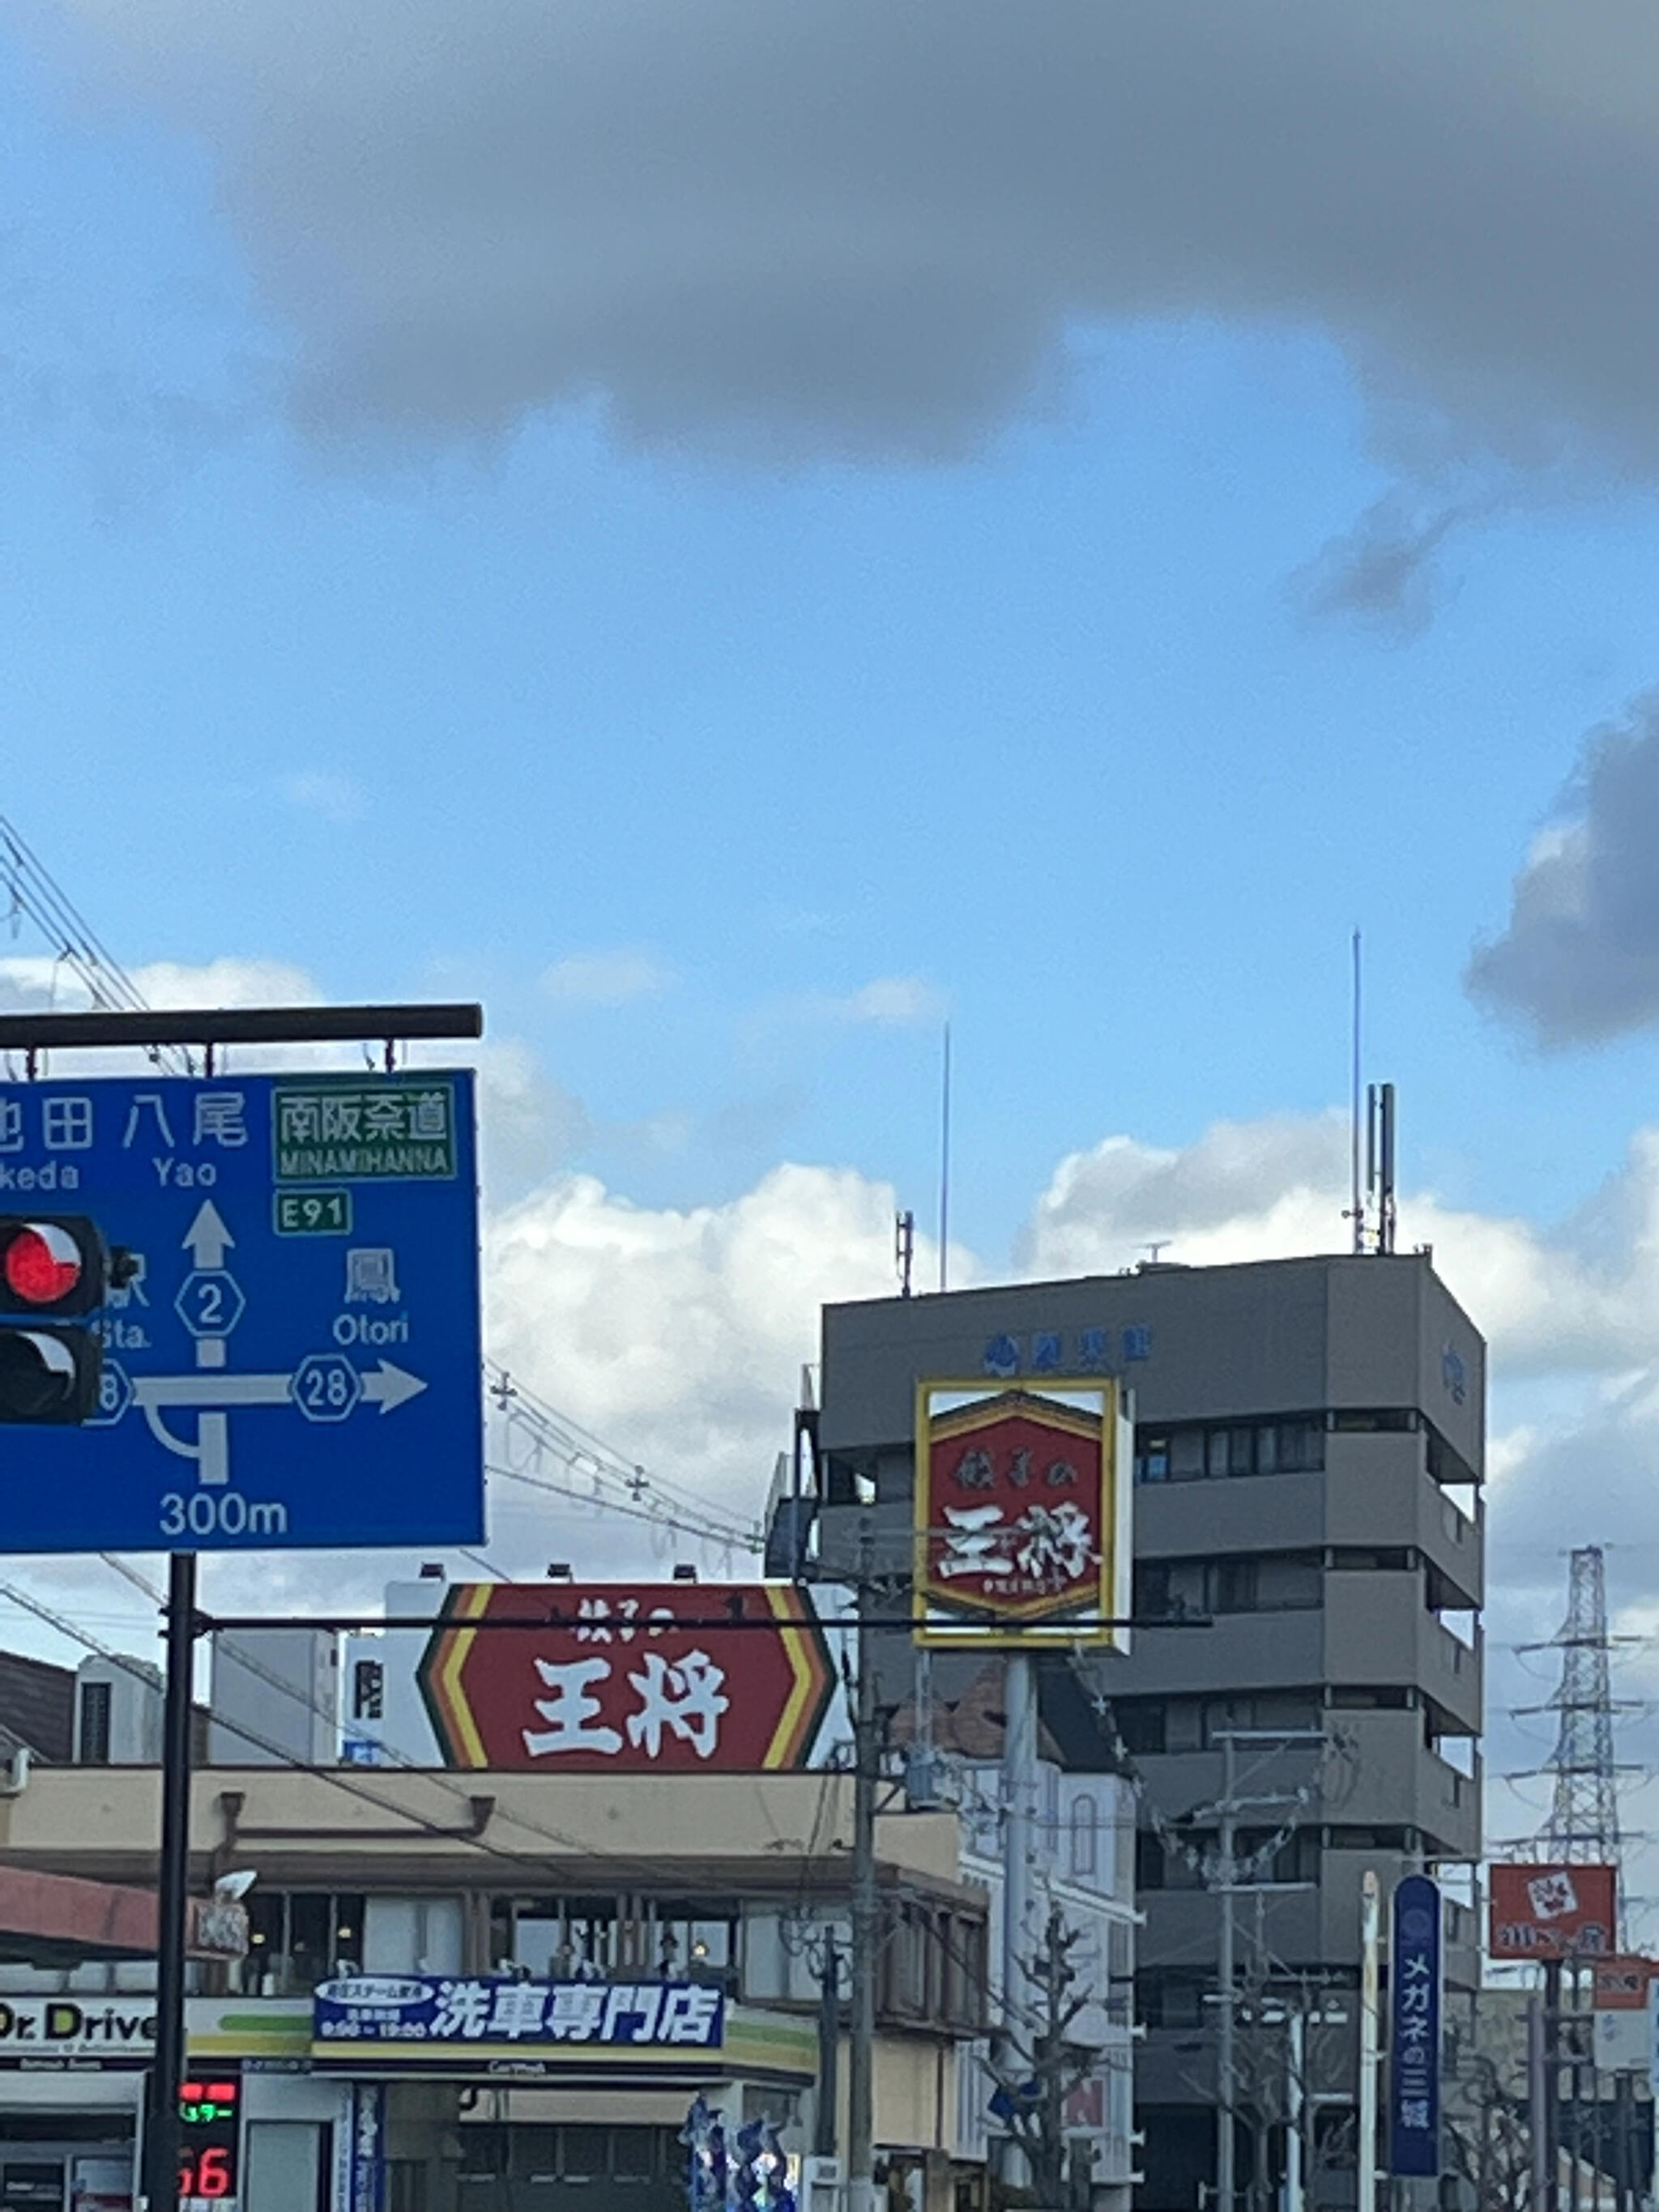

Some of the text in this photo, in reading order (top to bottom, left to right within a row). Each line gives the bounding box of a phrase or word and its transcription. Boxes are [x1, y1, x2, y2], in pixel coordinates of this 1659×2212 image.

[123, 1092, 248, 1149] 八尾
[280, 1092, 447, 1143] 南阪奈道
[151, 1157, 217, 1187] Yao
[280, 1148, 449, 1174] MINAMIHANNA
[284, 1196, 343, 1228] E91
[198, 1284, 223, 1323] 2
[332, 1311, 408, 1345] Otori
[305, 1369, 348, 1405] 28
[160, 1495, 288, 1535] 300m
[940, 1502, 1103, 1579] 王将
[522, 1649, 728, 1758] 王将
[429, 1980, 721, 2043] 洗車専門店
